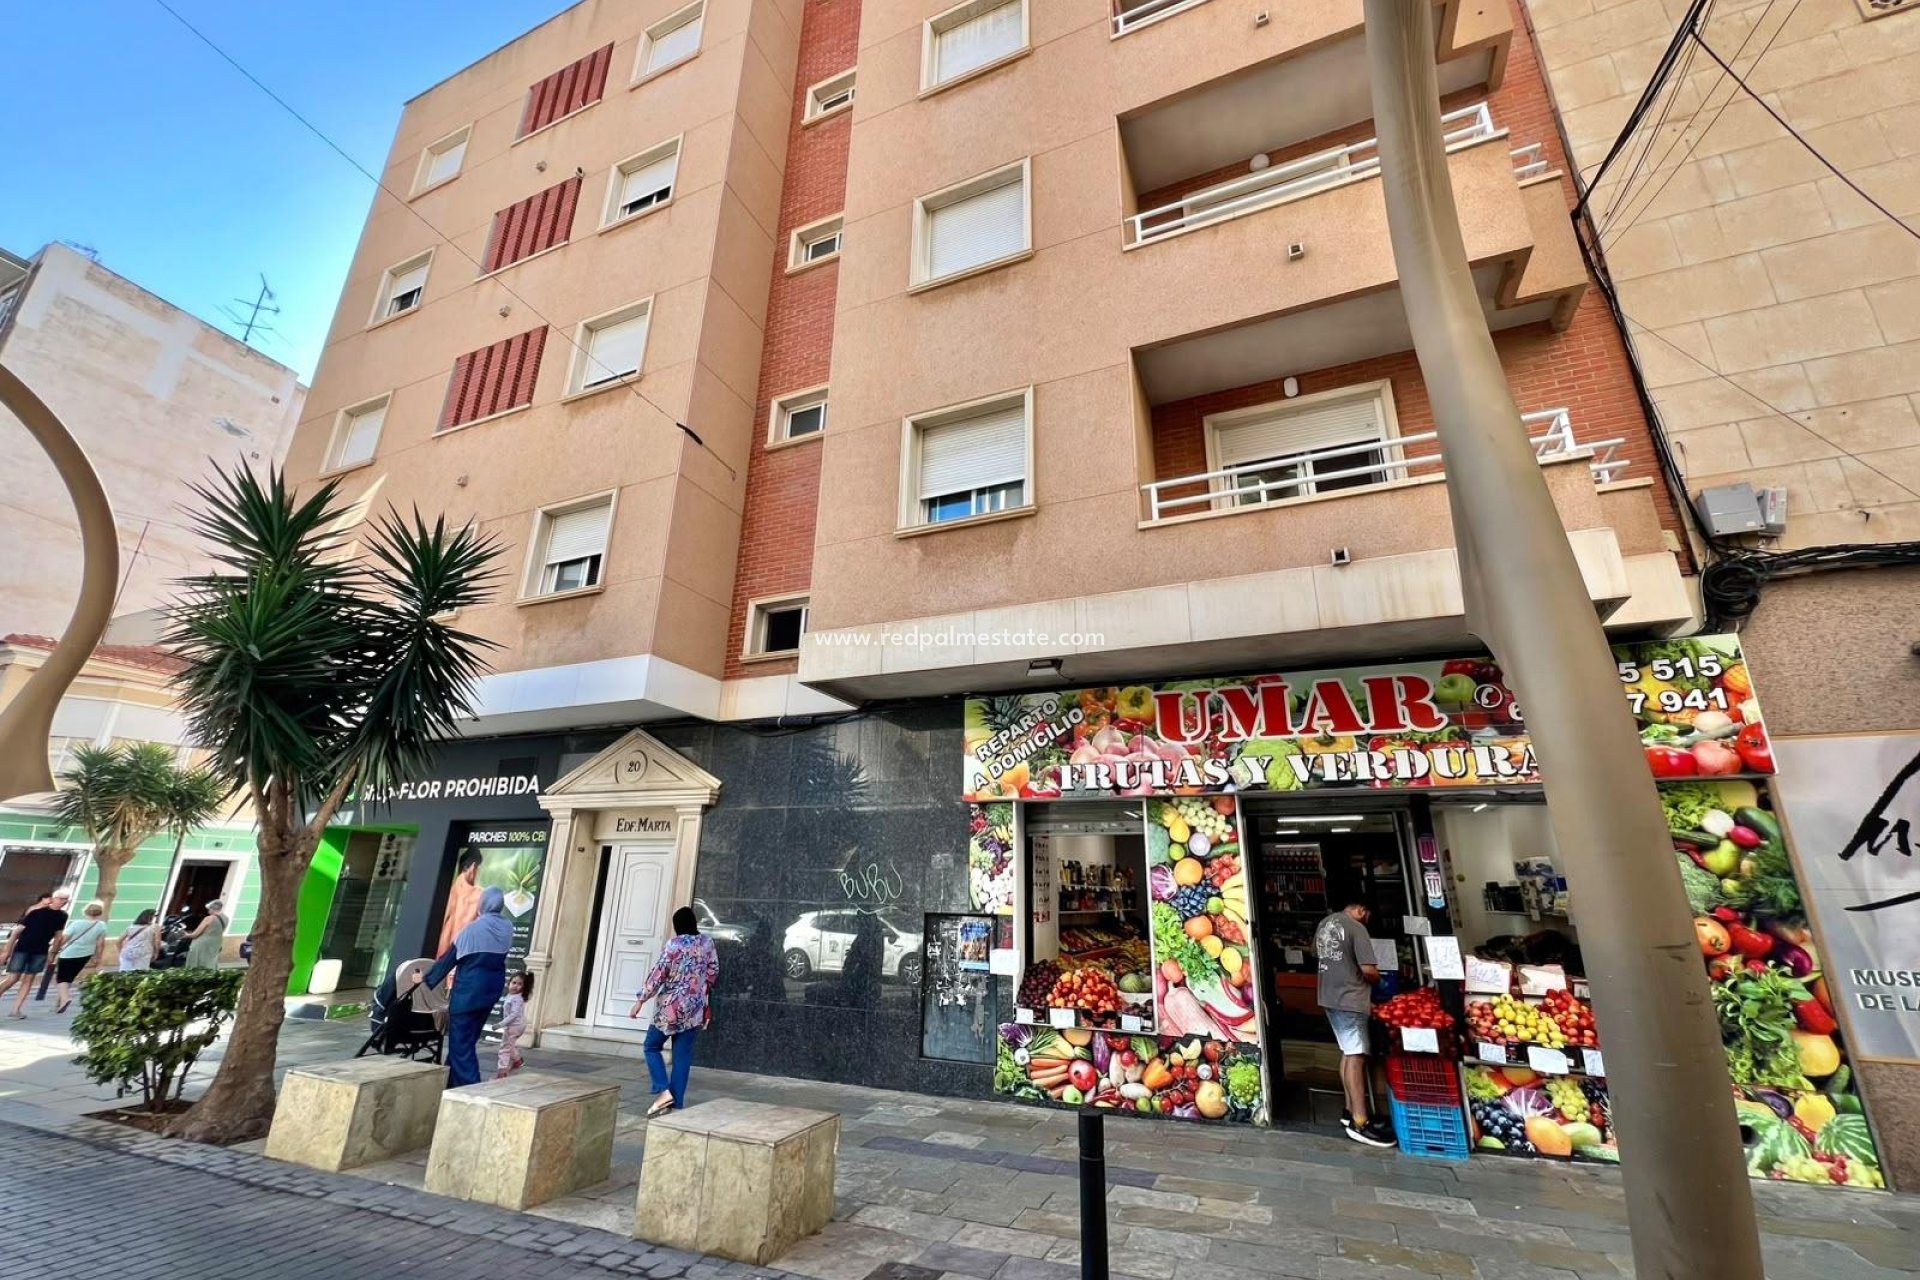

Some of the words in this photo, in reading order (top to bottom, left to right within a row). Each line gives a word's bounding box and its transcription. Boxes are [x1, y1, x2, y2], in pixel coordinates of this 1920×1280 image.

[1652, 655, 1722, 680] 515
[1154, 673, 1448, 745] UMAR
[1659, 687, 1728, 712] 941
[976, 699, 1057, 761] REPARTO
[973, 772, 989, 790] A
[988, 707, 1084, 779] DOMICILIO
[627, 760, 641, 773] 20
[1060, 757, 1232, 790] FRUTAS
[1241, 755, 1273, 786] Y
[444, 774, 540, 798] PROHIBIDA
[468, 831, 507, 843] PARCHES
[509, 831, 530, 843] 100%
[531, 830, 546, 842] CB
[1858, 993, 1897, 1011] DE
[1901, 995, 1920, 1012] L
